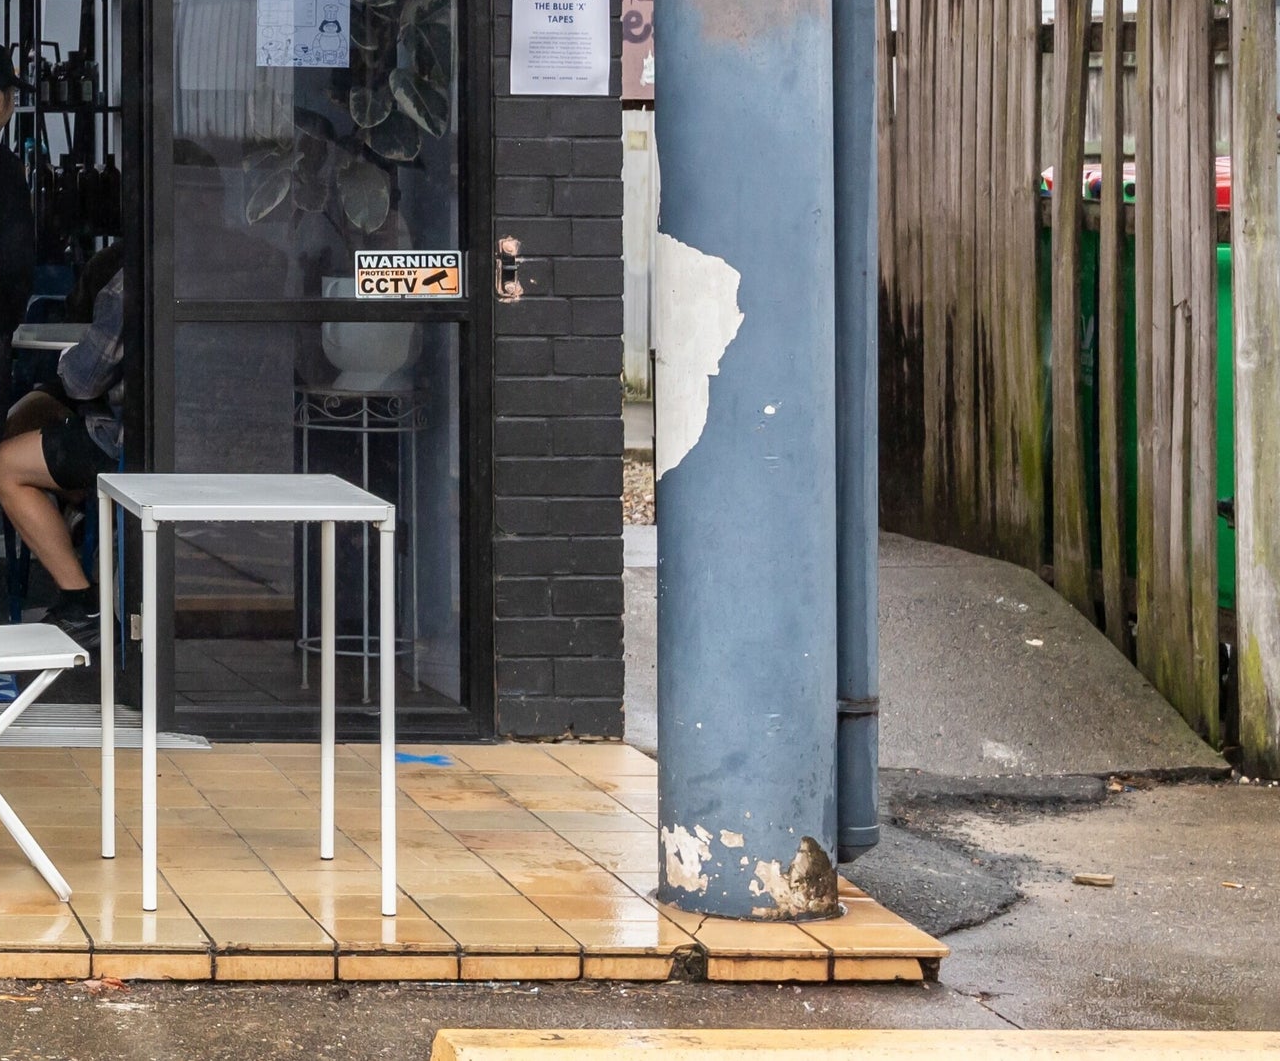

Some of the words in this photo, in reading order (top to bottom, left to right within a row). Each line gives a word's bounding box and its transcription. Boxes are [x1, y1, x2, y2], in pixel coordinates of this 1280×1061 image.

[534, 2, 551, 11] THE
[552, 2, 575, 11] BLUE
[548, 15, 575, 24] TAPES
[359, 255, 457, 268] WARNING
[360, 277, 418, 294] CCTV
